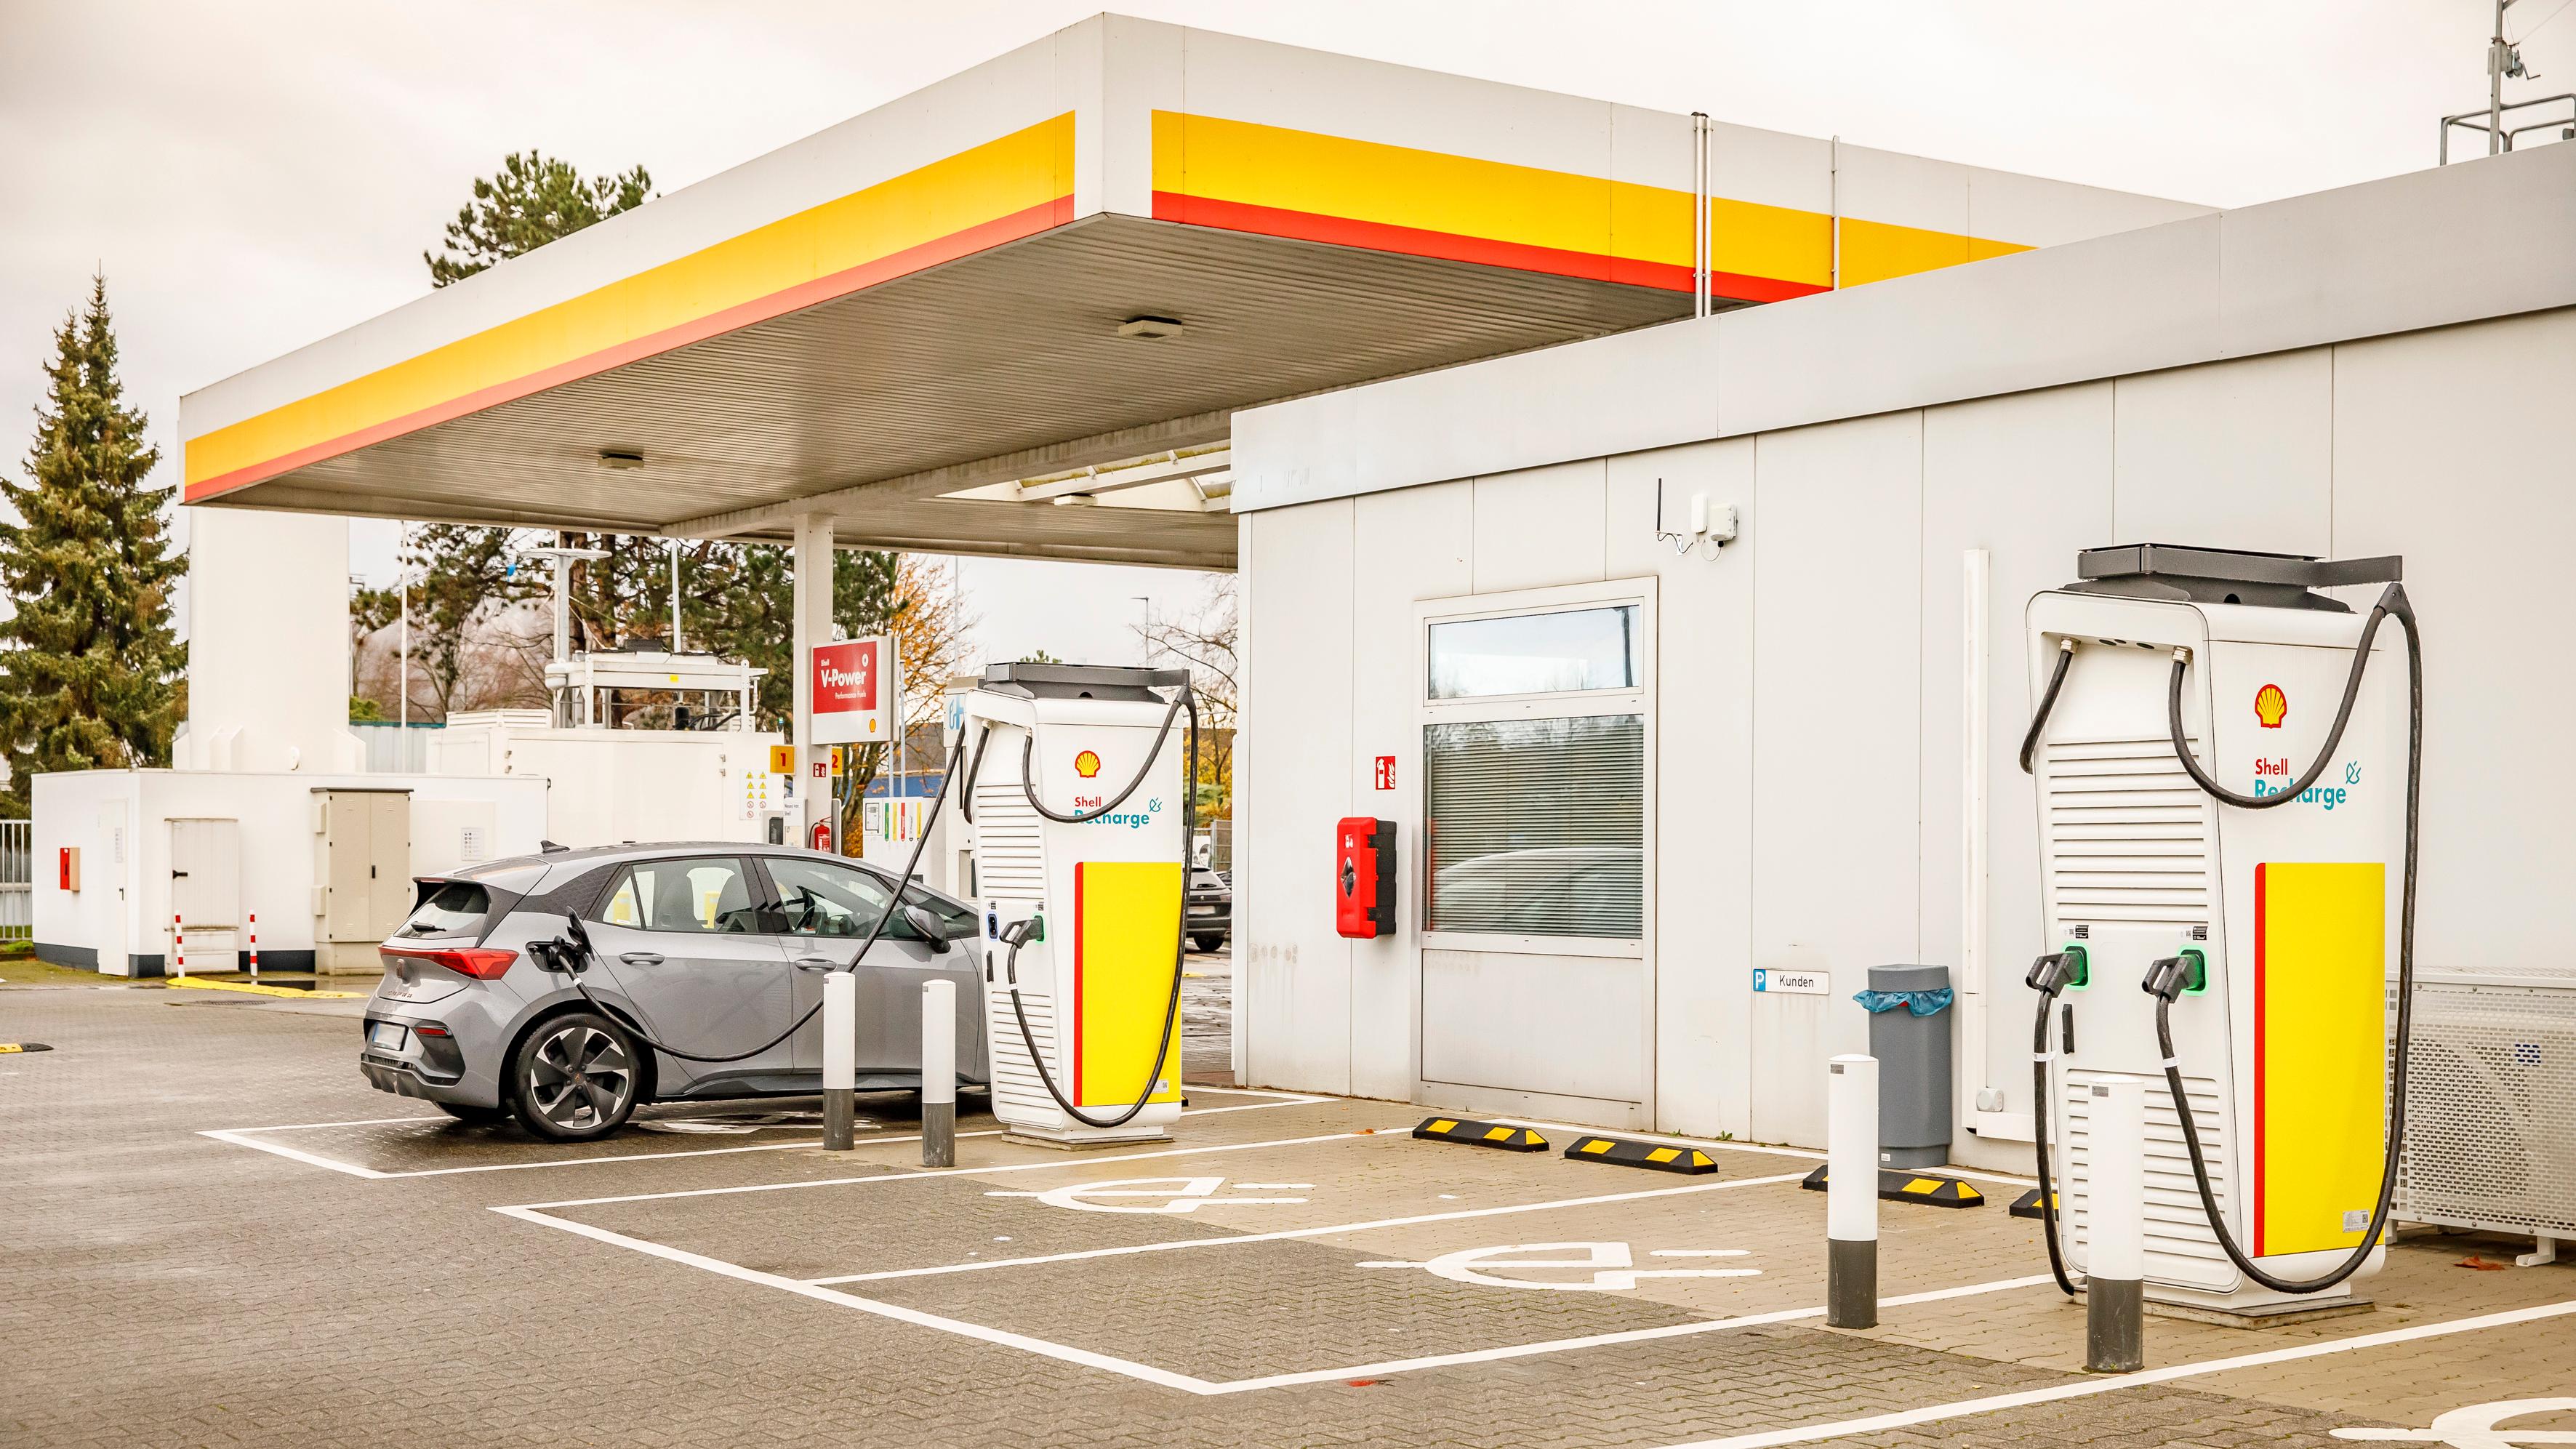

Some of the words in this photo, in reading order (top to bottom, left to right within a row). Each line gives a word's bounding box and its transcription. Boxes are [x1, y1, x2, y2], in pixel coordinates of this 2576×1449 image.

[821, 668, 867, 688] V-Power
[780, 752, 786, 767] 1
[832, 754, 838, 768] 2
[2255, 758, 2288, 776] Shell
[1075, 796, 1102, 807] Shell
[2255, 778, 2347, 811] Rearge
[1755, 971, 1765, 989] P
[1779, 974, 1814, 987] Kunden
